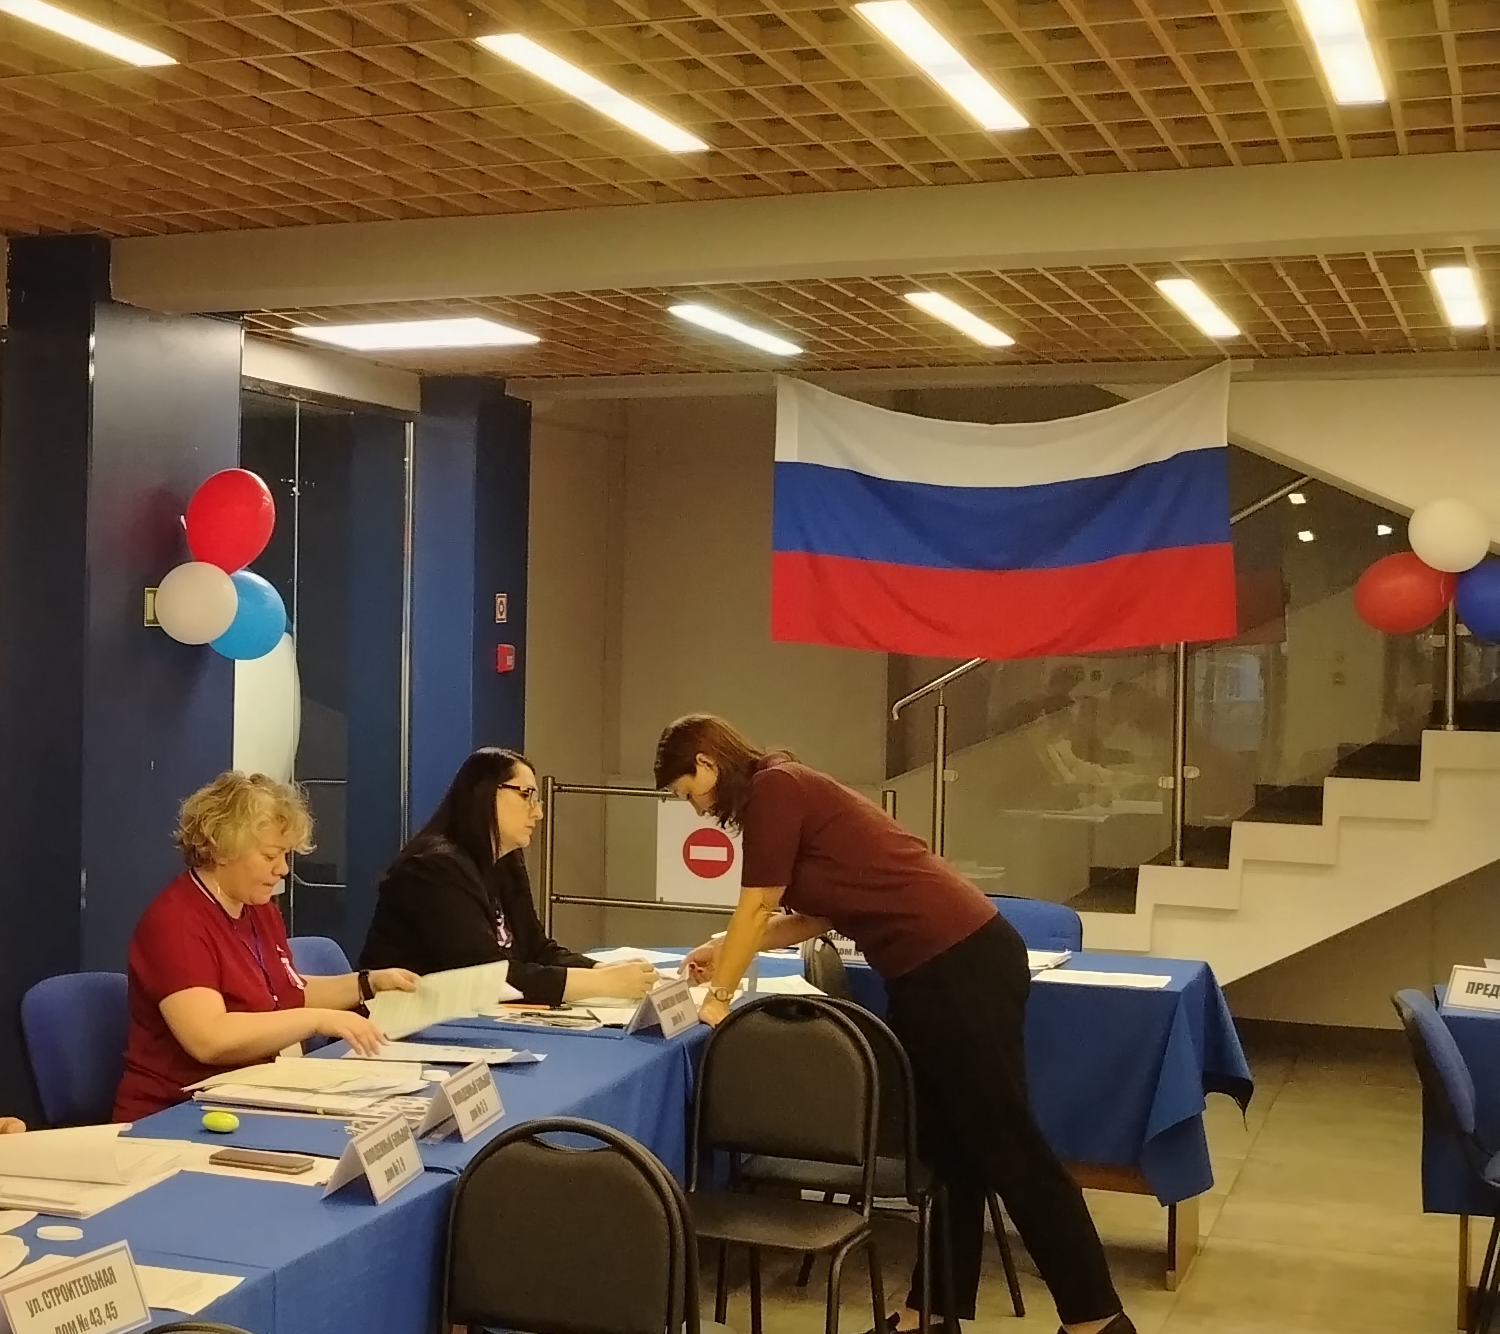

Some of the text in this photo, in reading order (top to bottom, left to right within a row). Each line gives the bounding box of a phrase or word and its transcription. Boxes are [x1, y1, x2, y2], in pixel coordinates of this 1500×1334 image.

[1465, 981, 1500, 1000] ПРЕД
[25, 1266, 117, 1318] УЛ. СТРОИТЕЛЬНАЯ
[76, 1313, 91, 1334] №
[89, 1307, 107, 1327] 43,
[104, 1301, 119, 1322] 45
